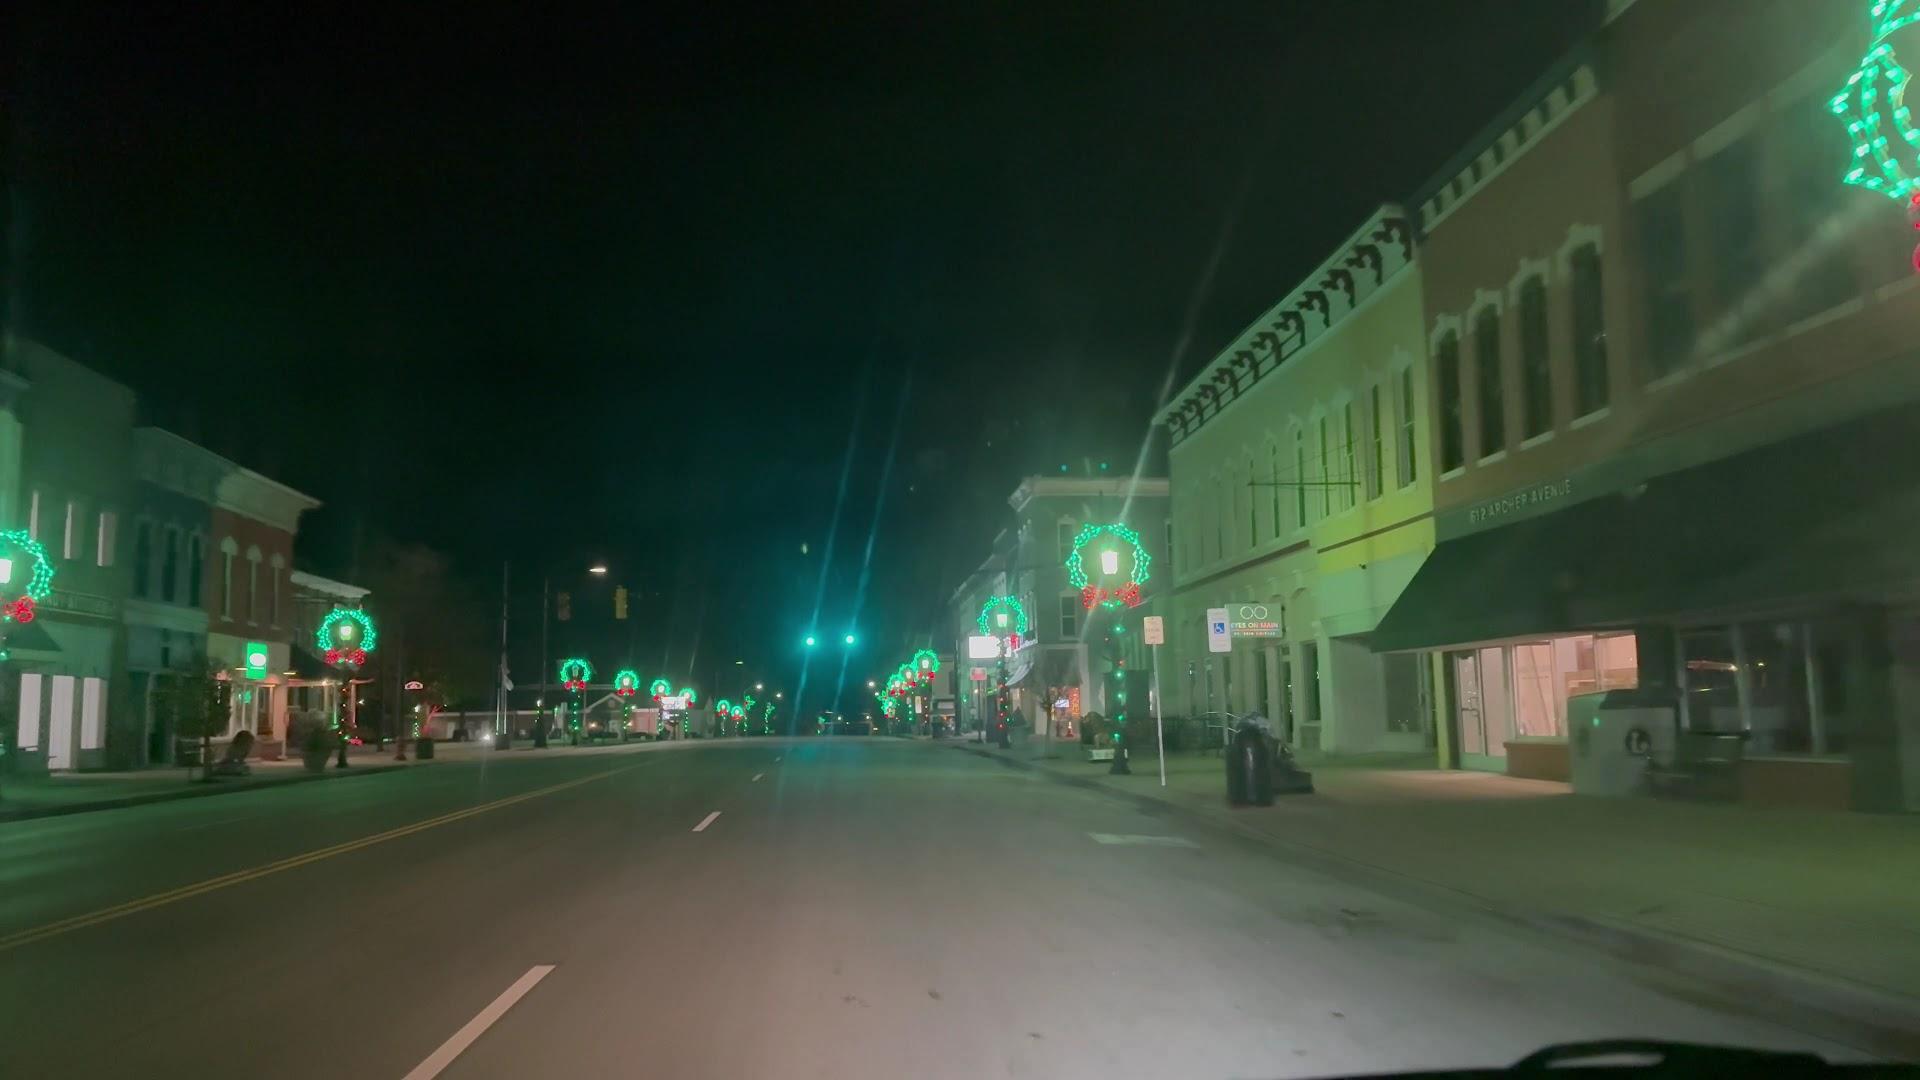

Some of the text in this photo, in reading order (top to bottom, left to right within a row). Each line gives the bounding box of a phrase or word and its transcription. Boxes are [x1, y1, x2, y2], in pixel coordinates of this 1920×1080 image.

[1470, 479, 1570, 523] 612 ARCHER AVENUE
